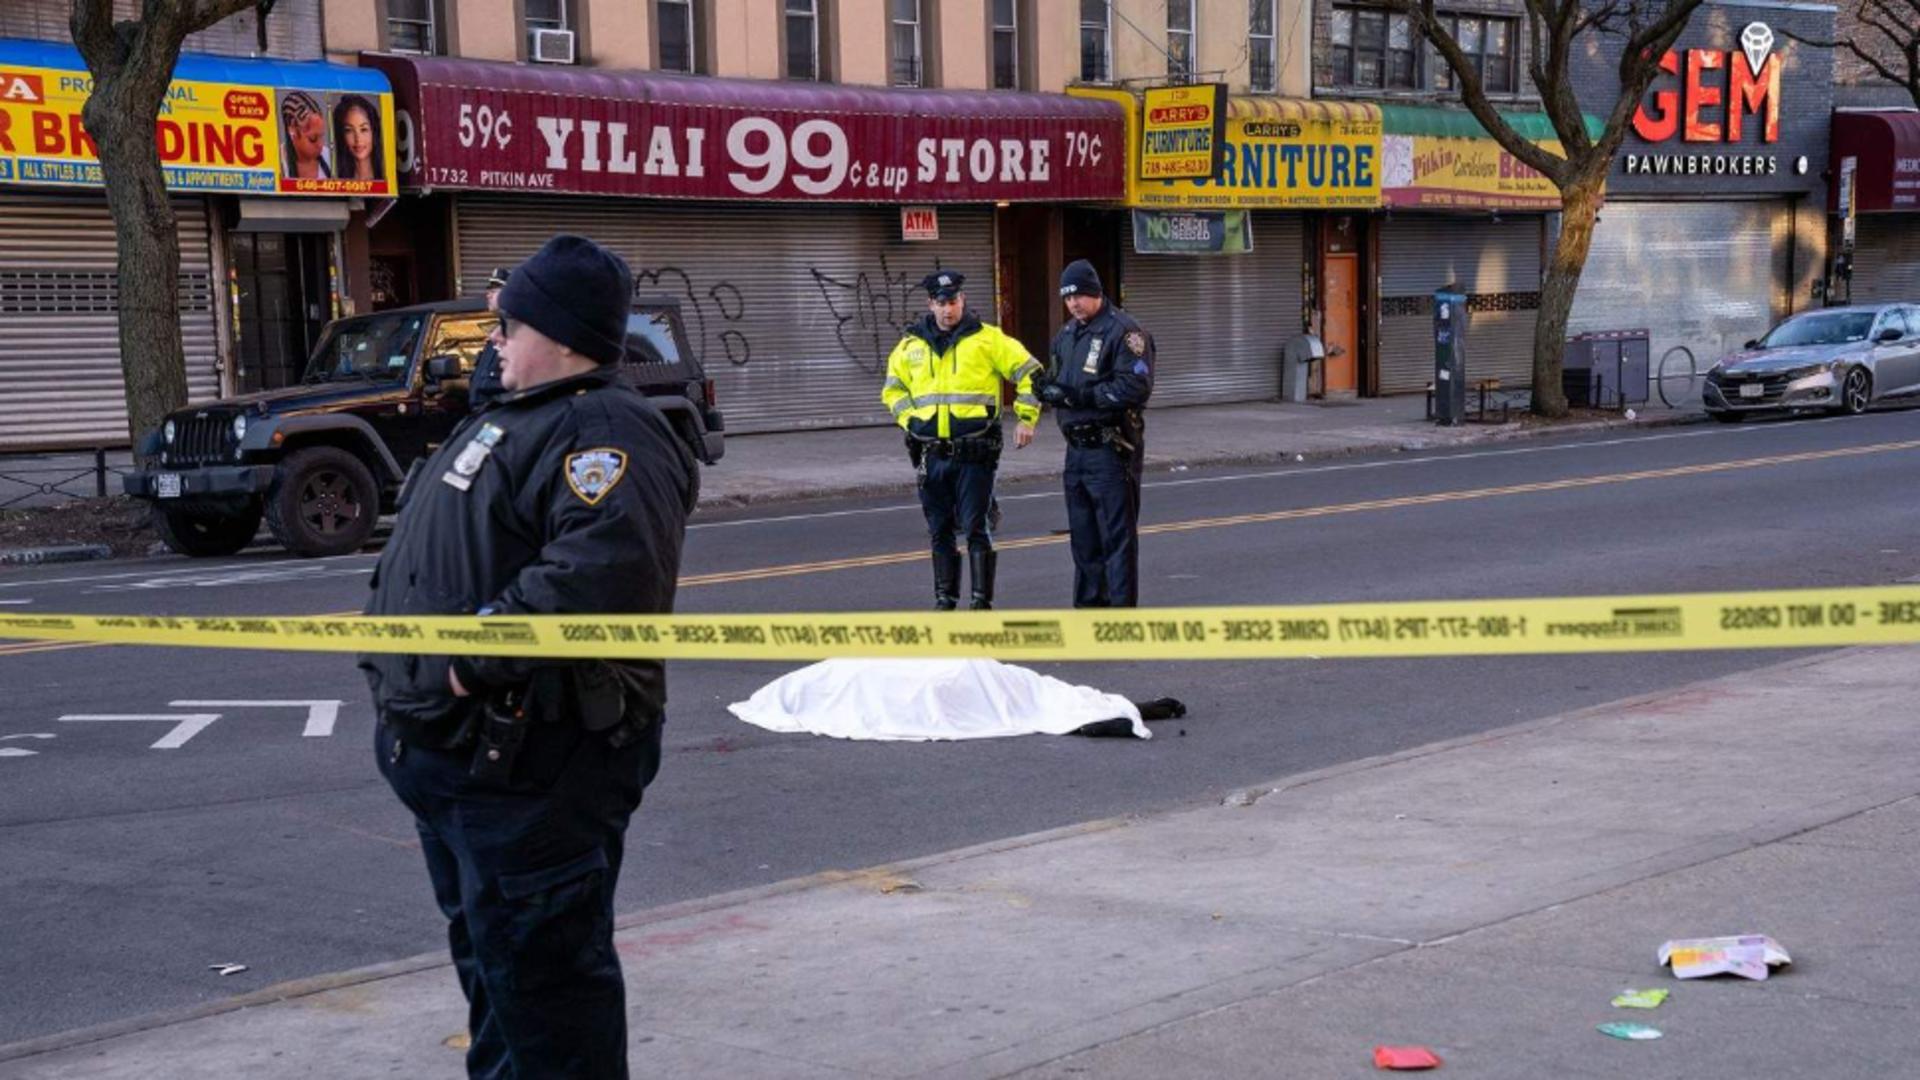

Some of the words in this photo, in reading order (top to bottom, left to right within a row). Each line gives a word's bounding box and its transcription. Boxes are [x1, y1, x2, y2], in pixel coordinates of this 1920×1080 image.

[0, 75, 39, 101] A
[1633, 49, 1781, 142] GEM
[32, 111, 265, 167] BRDING
[459, 104, 512, 150] 59¢
[1065, 131, 1102, 168] 79¢
[1145, 128, 1211, 154] FURNITURE
[537, 116, 705, 177] YILAI
[866, 163, 880, 187] &
[883, 167, 908, 194] up
[917, 138, 1050, 182] STORE
[1627, 154, 1777, 175] PAWNBROKERS
[430, 167, 469, 183] 1732
[480, 171, 525, 185] PITKIN
[528, 174, 554, 187] AVE
[905, 211, 935, 229] ATM
[1147, 217, 1170, 239] NO
